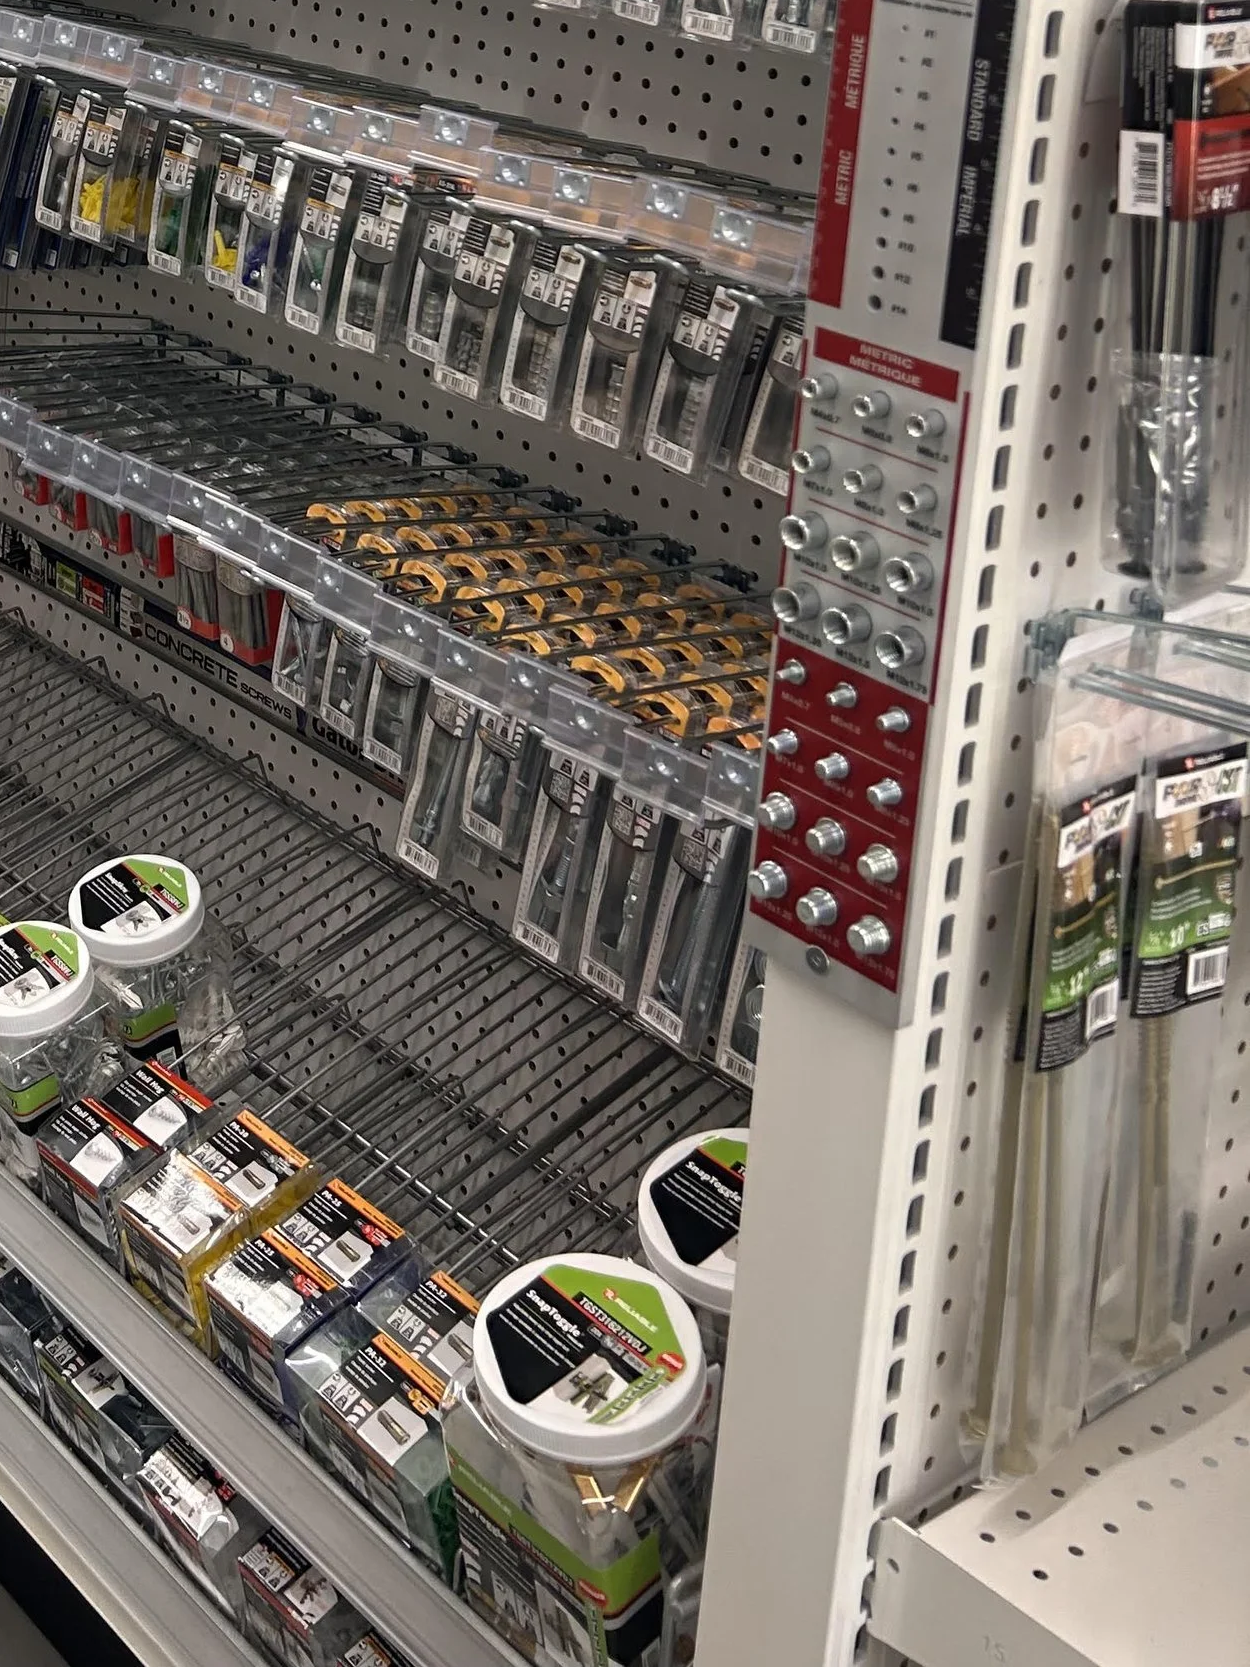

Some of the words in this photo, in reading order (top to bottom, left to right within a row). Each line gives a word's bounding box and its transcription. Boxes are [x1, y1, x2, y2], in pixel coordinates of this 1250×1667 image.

[967, 58, 991, 142] STANDARD
[834, 150, 854, 206] METRIC
[859, 343, 914, 370] METRIC
[145, 625, 238, 689] CONCRETE
[240, 682, 291, 718] SCREWS
[136, 1069, 151, 1083] Wall
[150, 1080, 166, 1095] Hog
[71, 1104, 89, 1120] Wall
[85, 1115, 101, 1130] Hog
[321, 1190, 342, 1208] PA-25
[425, 1281, 448, 1299] PA-32
[365, 1346, 387, 1368] PA-32
